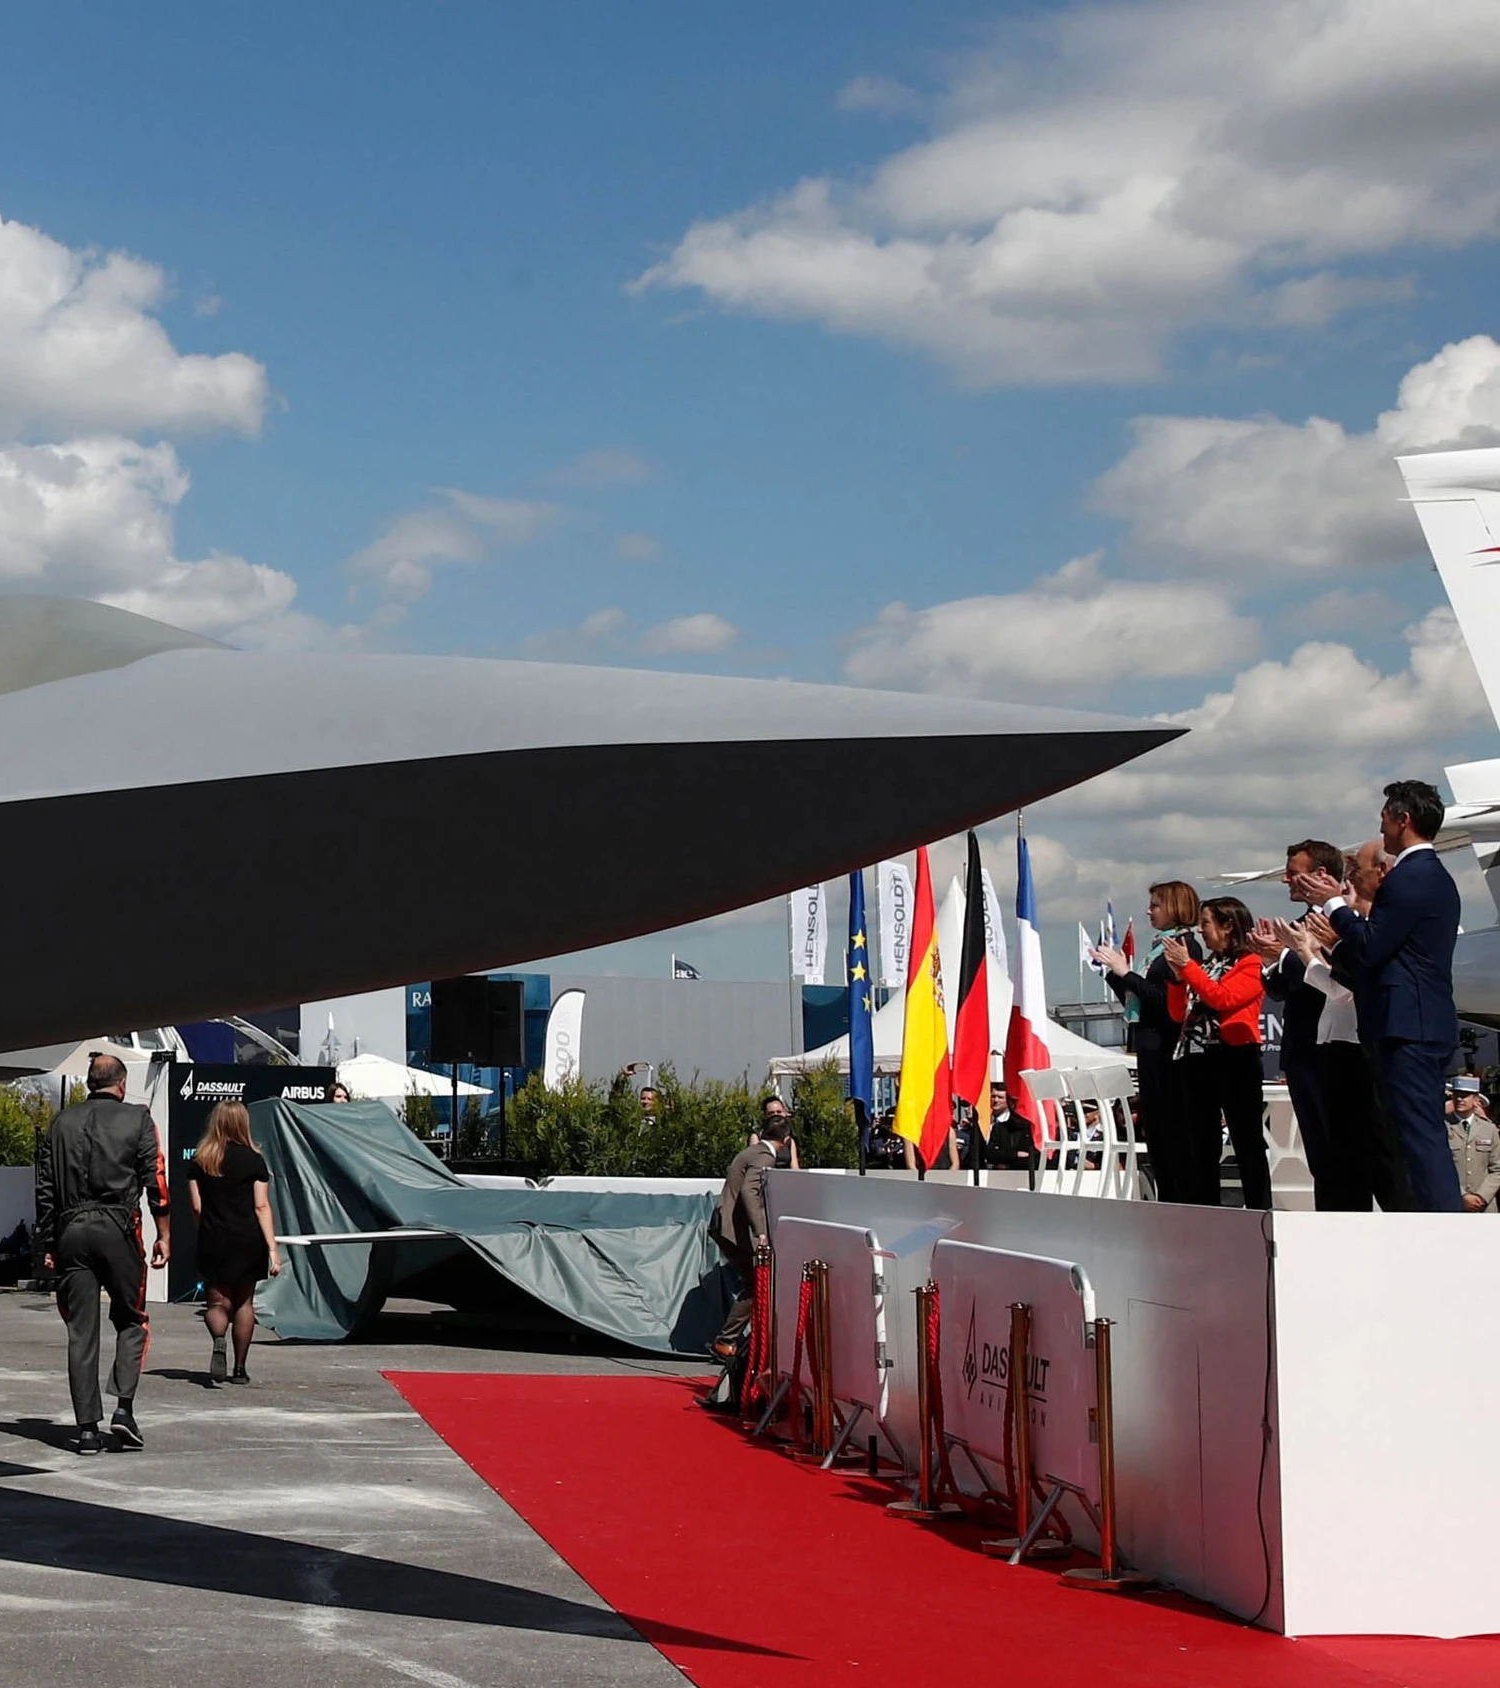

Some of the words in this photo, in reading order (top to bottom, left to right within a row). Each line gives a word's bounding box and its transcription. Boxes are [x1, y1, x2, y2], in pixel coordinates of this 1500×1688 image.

[893, 873, 905, 973] HENSOLDT
[196, 1082, 246, 1093] DASSAULT
[281, 1086, 325, 1099] AIRBUS
[982, 1342, 1050, 1392] DASULT
[980, 1392, 1047, 1427] AVION
